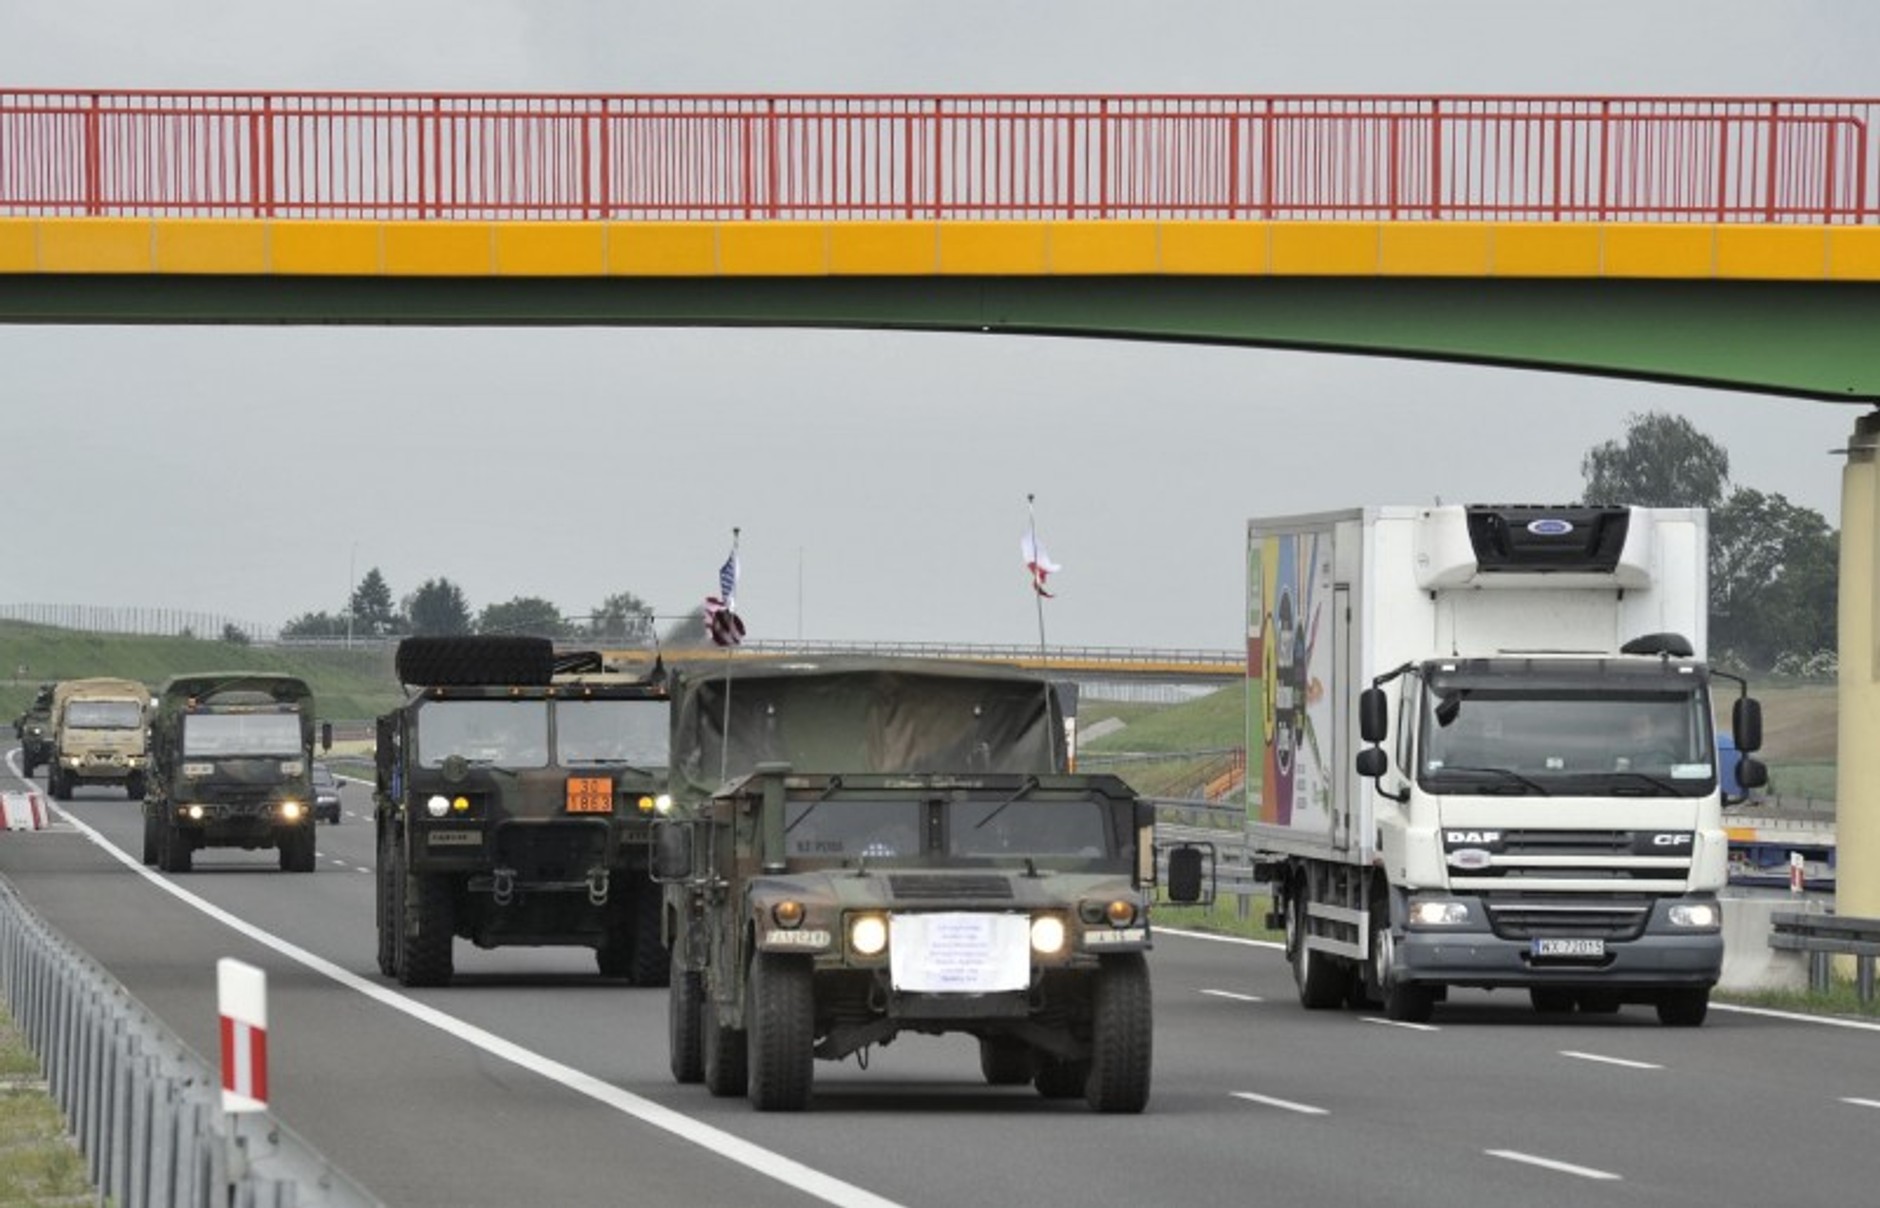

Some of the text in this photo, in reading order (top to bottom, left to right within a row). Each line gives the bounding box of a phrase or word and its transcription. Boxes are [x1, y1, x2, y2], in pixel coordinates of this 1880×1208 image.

[580, 780, 598, 793] 30
[1447, 831, 1500, 843] DAF
[1653, 834, 1692, 845] CF
